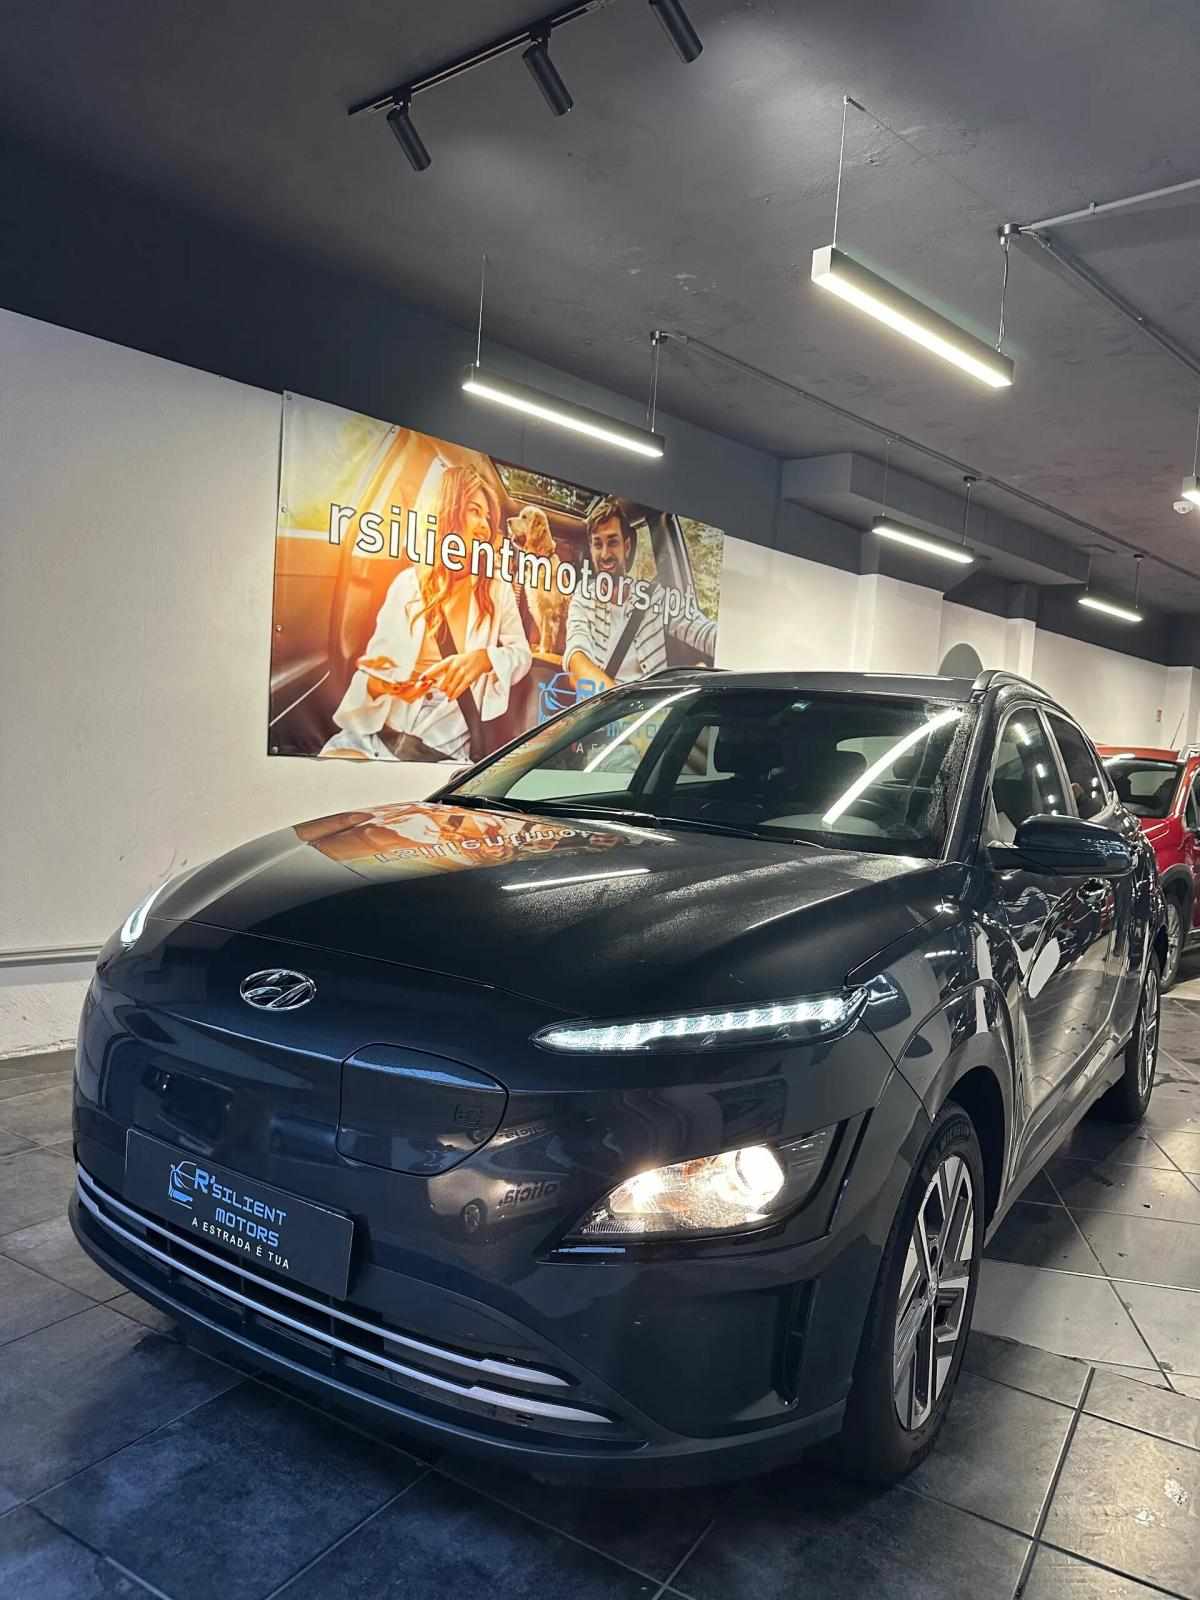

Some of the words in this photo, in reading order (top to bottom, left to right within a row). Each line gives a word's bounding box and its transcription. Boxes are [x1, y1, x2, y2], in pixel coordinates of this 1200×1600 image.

[328, 502, 697, 626] rsilientmotors.pt
[191, 1217, 199, 1228] A
[202, 1223, 251, 1252] ESTRADA
[256, 1245, 263, 1257] É
[268, 1252, 290, 1270] TUA
[215, 1207, 279, 1248] MOTORS
